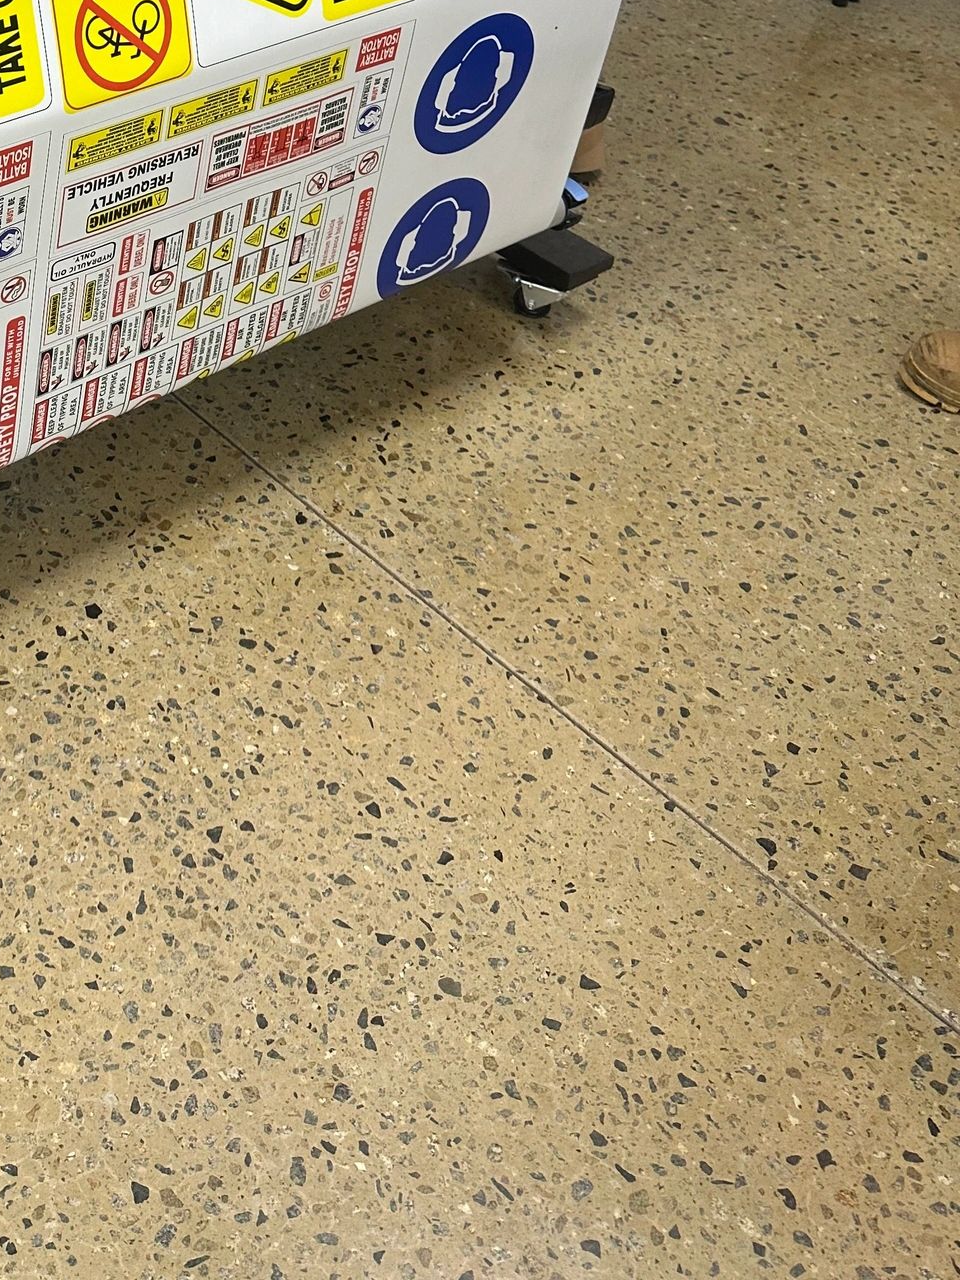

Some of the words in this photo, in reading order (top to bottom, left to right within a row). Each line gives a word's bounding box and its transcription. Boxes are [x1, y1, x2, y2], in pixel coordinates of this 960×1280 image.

[360, 46, 394, 67] BATTERY
[362, 32, 399, 54] ISOLATOR
[128, 144, 199, 179] REVERSING
[67, 175, 123, 200] VEHICLE
[90, 172, 173, 211] FREQUENTLY
[90, 196, 153, 228] WARNING
[14, 343, 22, 378] UNLADEN
[1, 385, 17, 417] PROP
